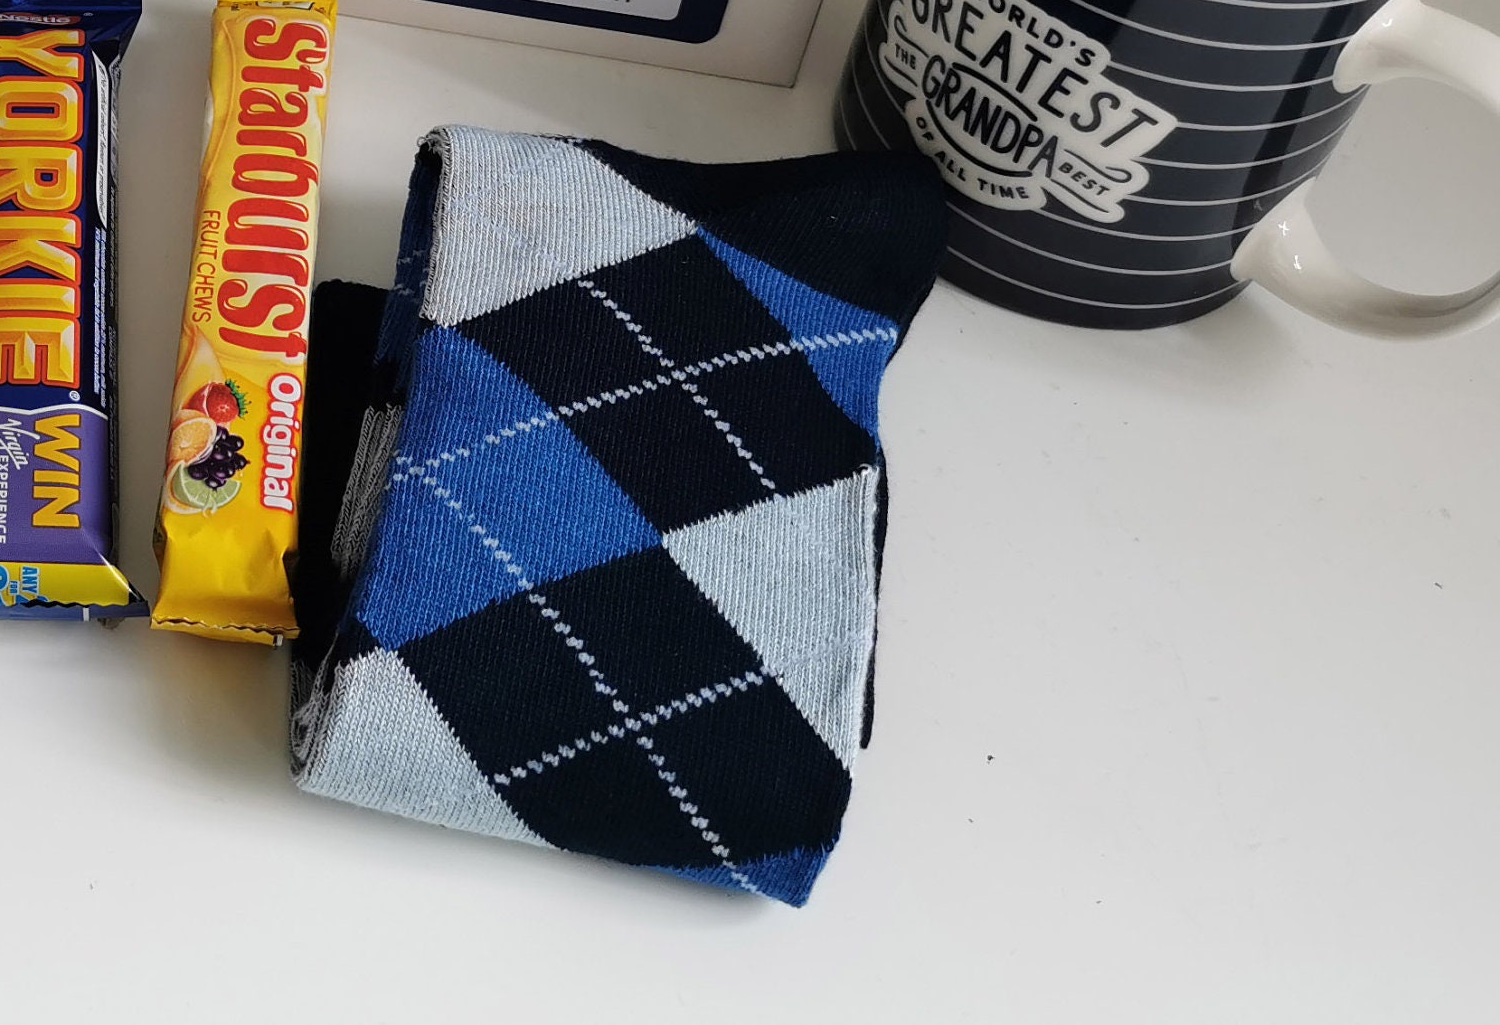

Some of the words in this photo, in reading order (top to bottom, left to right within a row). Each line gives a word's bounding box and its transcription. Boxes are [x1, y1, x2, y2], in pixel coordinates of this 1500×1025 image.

[894, 44, 917, 70] THE
[921, 54, 1060, 179] GRANDPA
[1058, 160, 1111, 197] BEST
[915, 116, 935, 144] OF
[934, 150, 968, 183] ALL
[977, 177, 1030, 200] TIME
[216, 18, 328, 359] Starburst
[199, 210, 221, 264] FRUIT
[192, 261, 217, 323] CHEWS
[32, 414, 81, 529] WIN
[262, 374, 301, 512] Original
[9, 581, 19, 594] FOR
[22, 566, 40, 592] ANY
